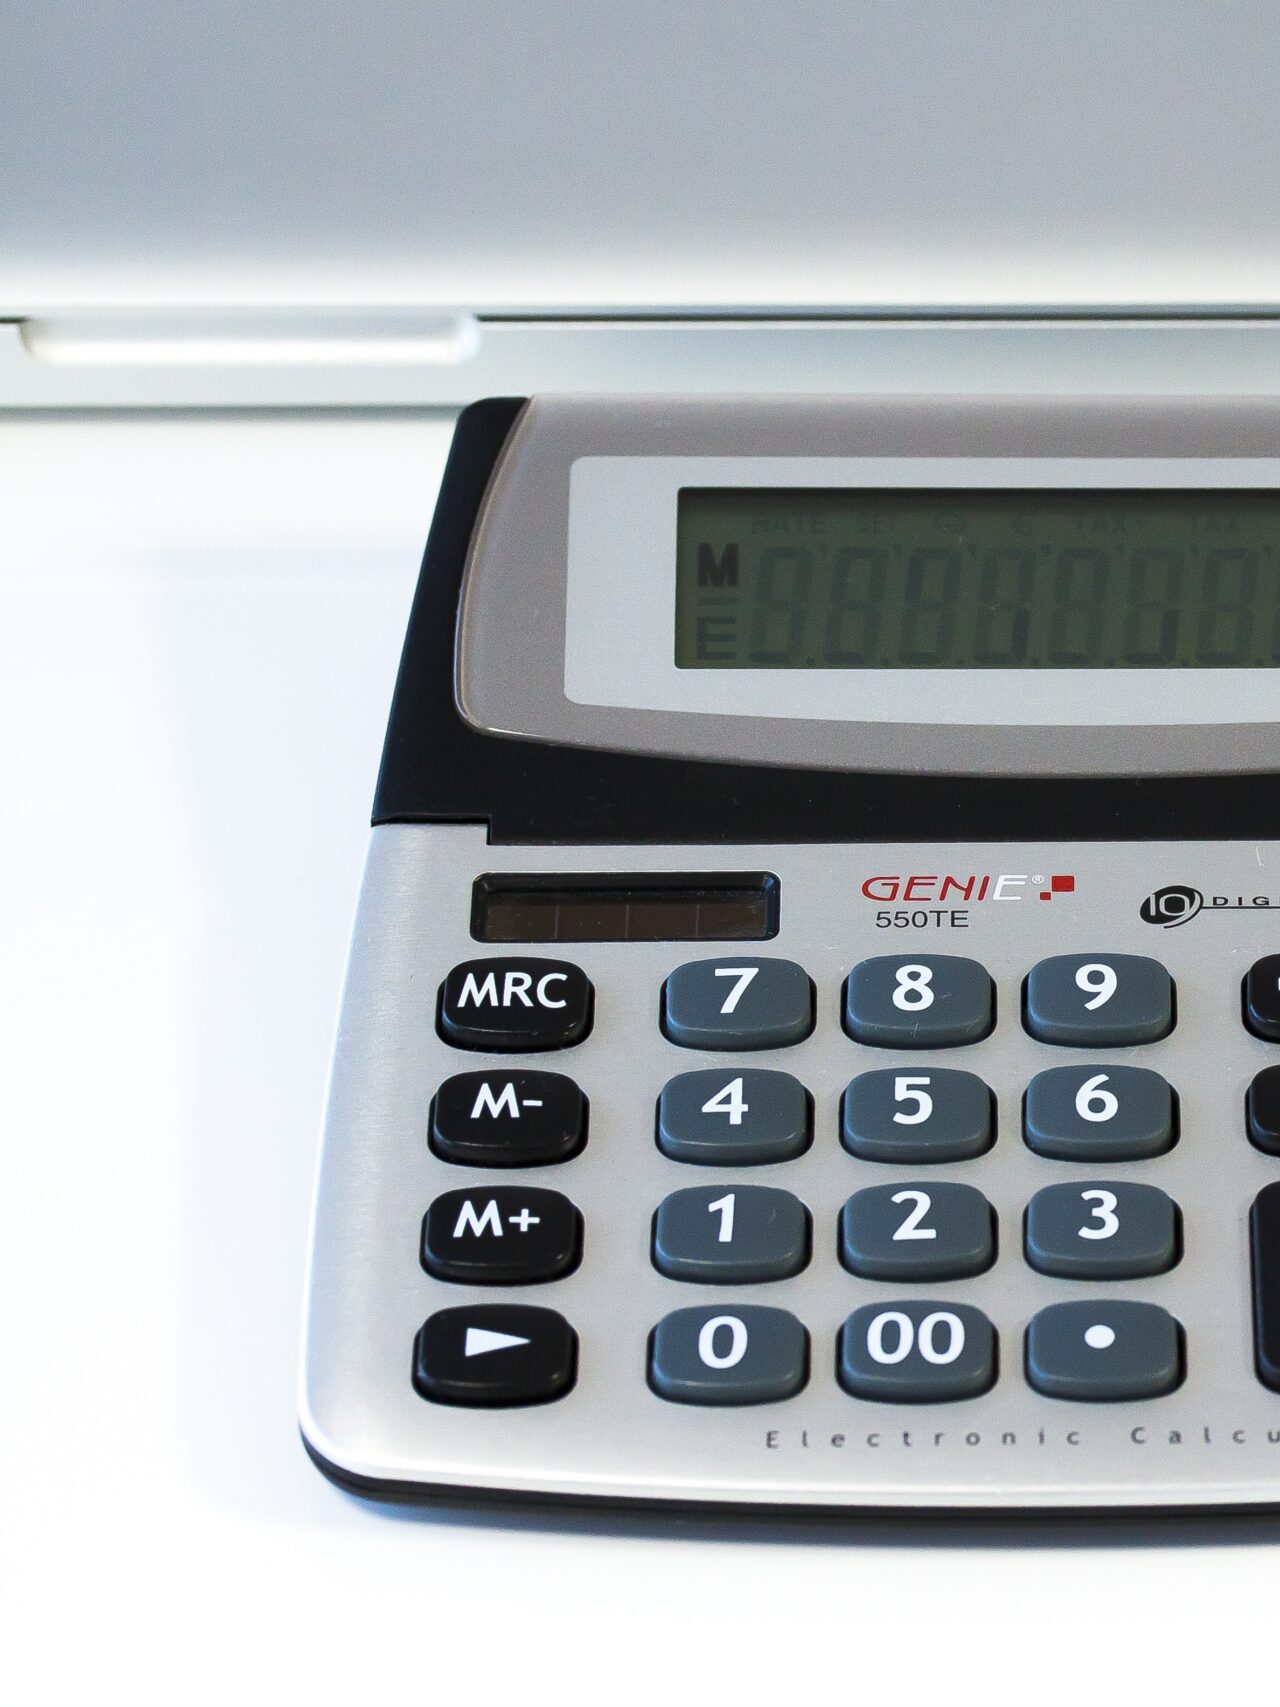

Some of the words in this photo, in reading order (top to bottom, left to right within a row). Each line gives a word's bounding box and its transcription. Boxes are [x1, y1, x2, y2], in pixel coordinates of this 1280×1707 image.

[696, 542, 740, 589] M
[695, 615, 737, 661] E
[875, 910, 969, 928] 550TE
[456, 972, 568, 1009] MRC
[713, 967, 760, 1014] 7
[891, 964, 935, 1012] 8
[1075, 963, 1118, 1011] 9
[470, 1081, 544, 1120] M-
[701, 1077, 749, 1125] 4
[892, 1076, 933, 1125] 5
[1075, 1073, 1119, 1122] 6
[452, 1199, 541, 1238] M+
[707, 1193, 736, 1243] 1
[891, 1190, 937, 1241] 2
[1077, 1189, 1120, 1240] 3
[697, 1315, 748, 1369] 0
[867, 1311, 966, 1365] 00
[765, 1429, 1081, 1449] Electronic
